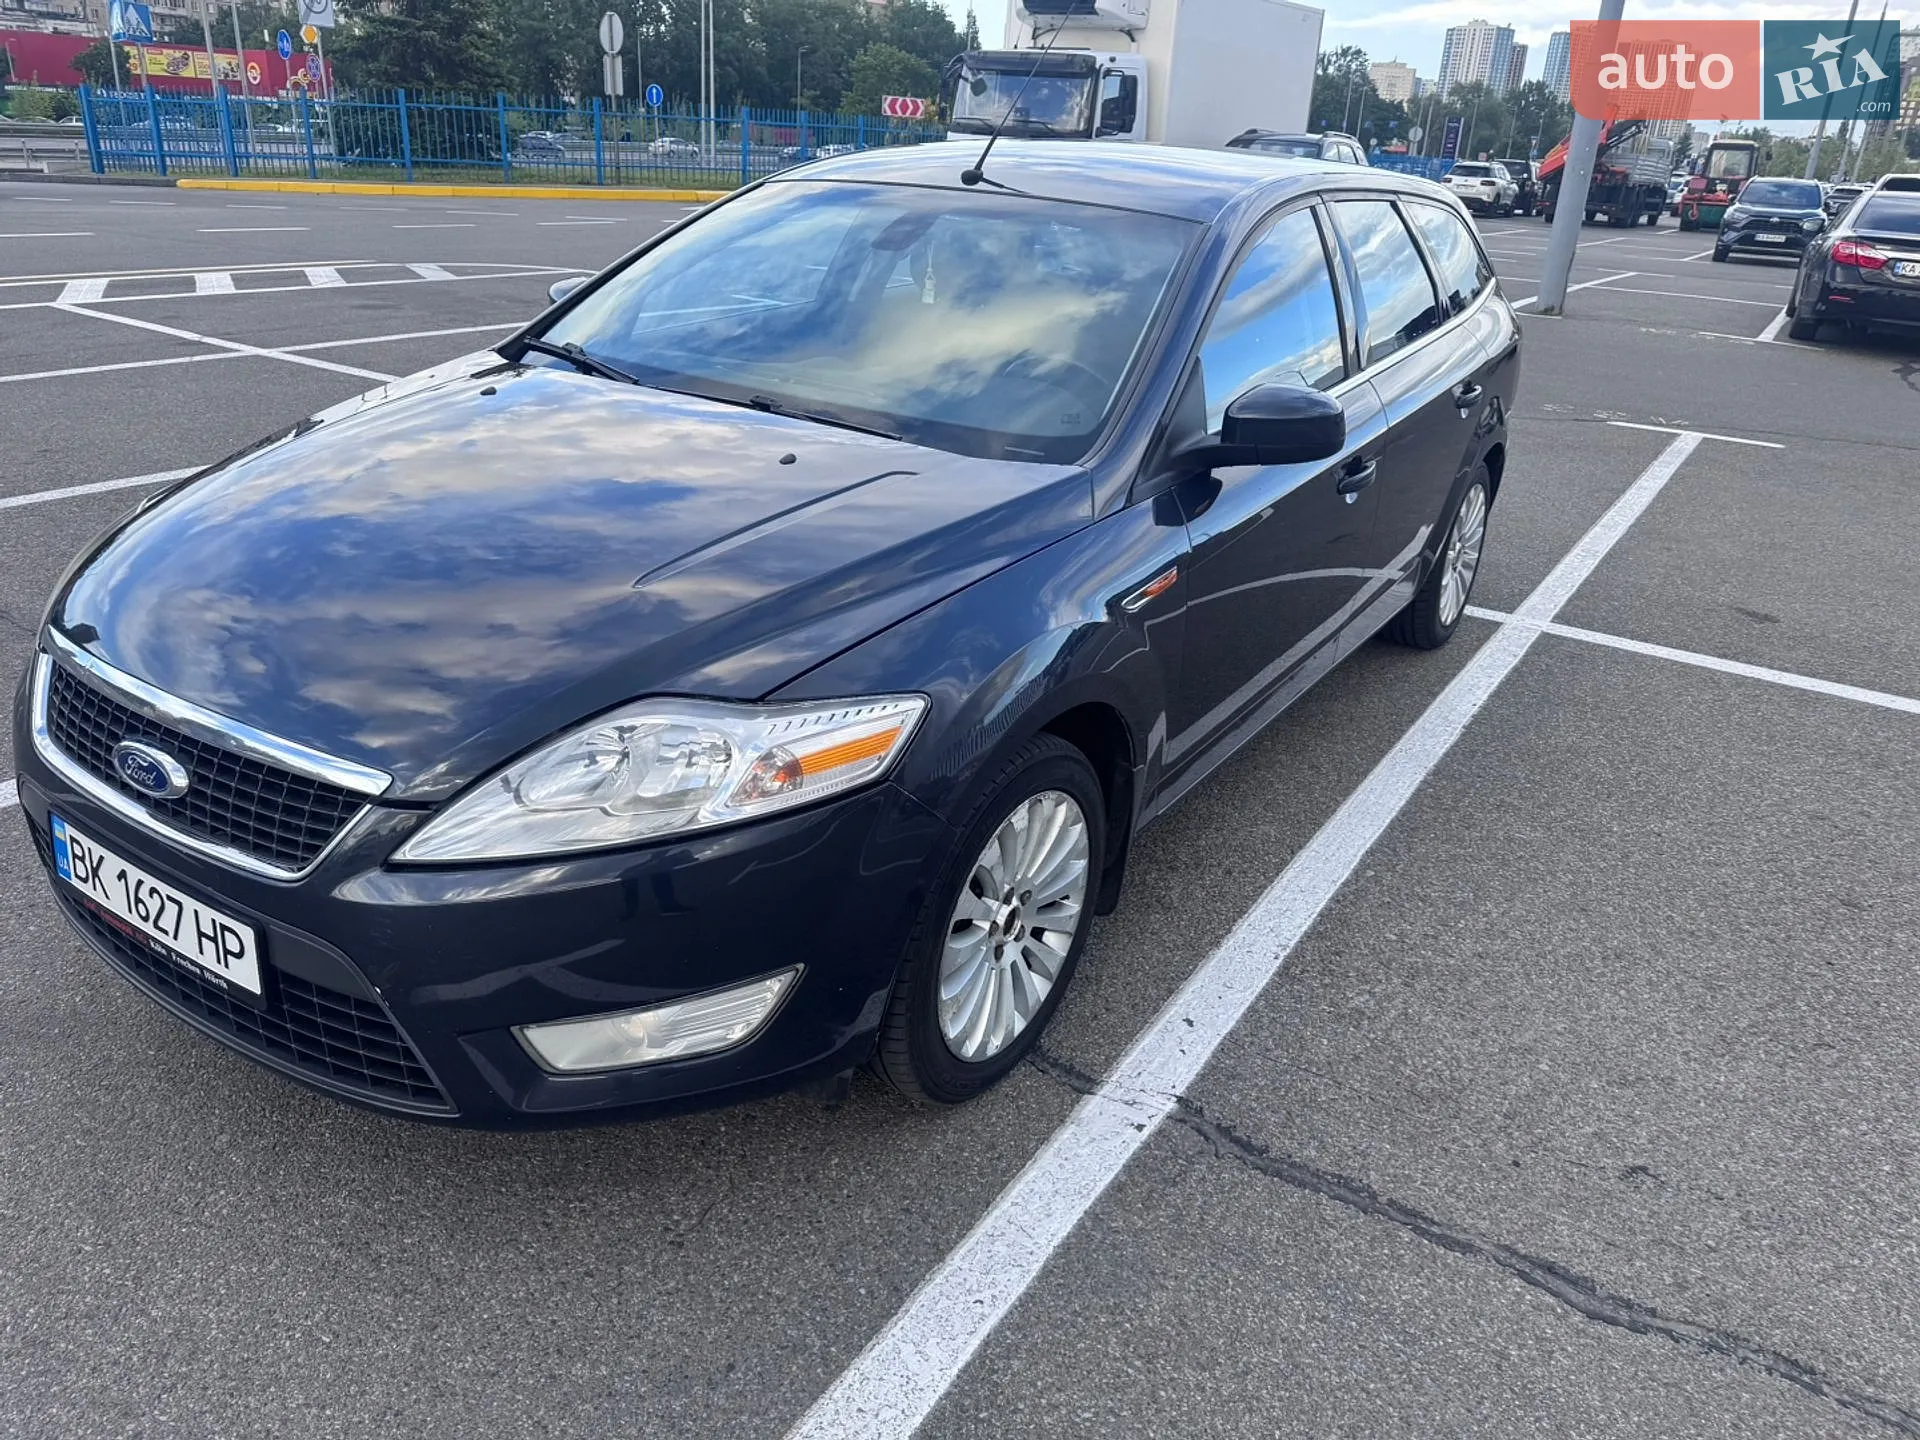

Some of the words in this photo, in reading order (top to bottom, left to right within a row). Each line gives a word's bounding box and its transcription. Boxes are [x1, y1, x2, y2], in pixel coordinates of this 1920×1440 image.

[1902, 263, 1916, 273] KA
[126, 755, 157, 786] Ford
[58, 852, 71, 873] UA
[69, 834, 111, 900] BK
[117, 868, 184, 941] 1627
[193, 908, 245, 969] HP
